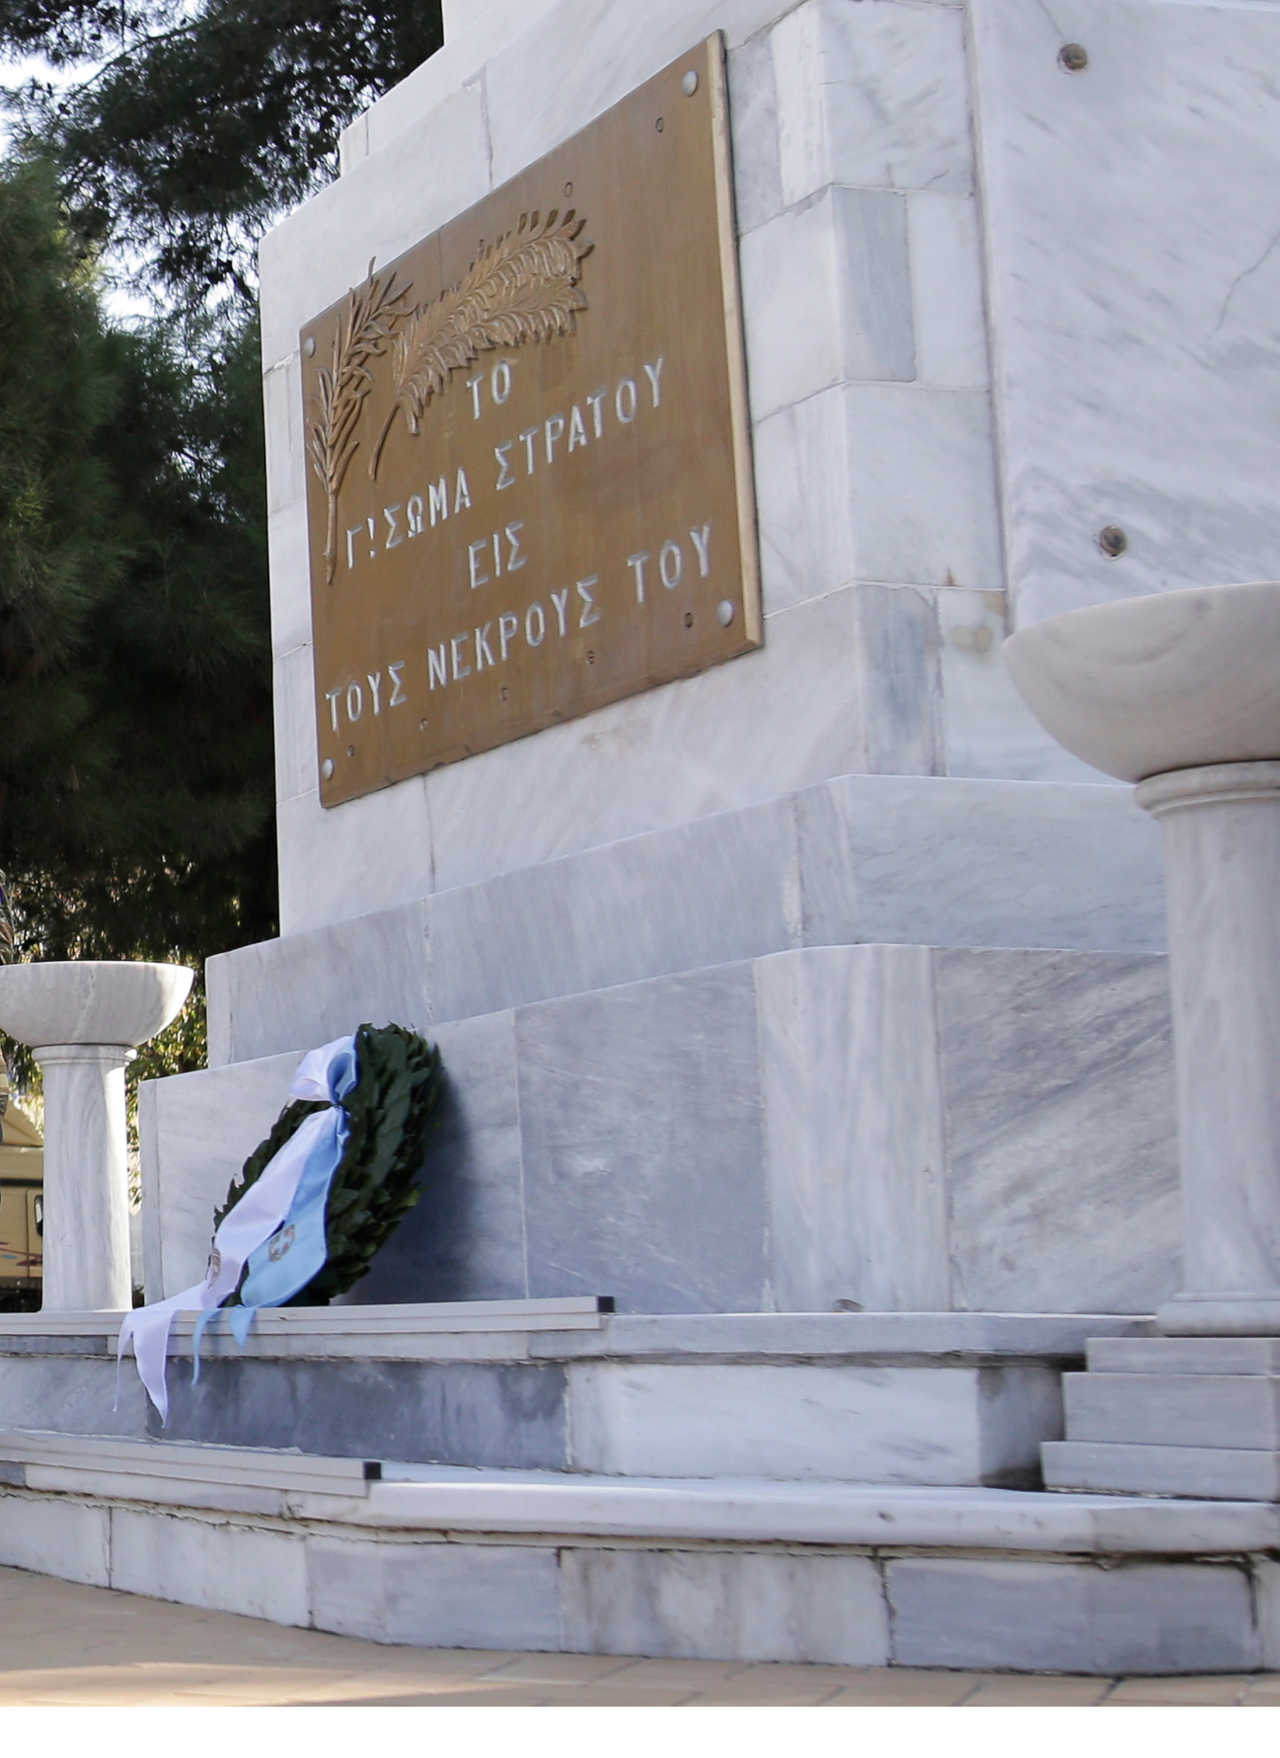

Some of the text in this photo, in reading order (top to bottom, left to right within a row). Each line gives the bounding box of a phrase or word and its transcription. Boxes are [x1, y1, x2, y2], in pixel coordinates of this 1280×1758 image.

[466, 359, 512, 420] ΤΟ
[494, 357, 664, 491] ΣΤΡΑΤΟΥ
[468, 520, 527, 590] ΕΙΣ
[325, 521, 711, 733] ΤΟΥΣ ΝΕΚΡΟΥΣ ΤΟΥ
